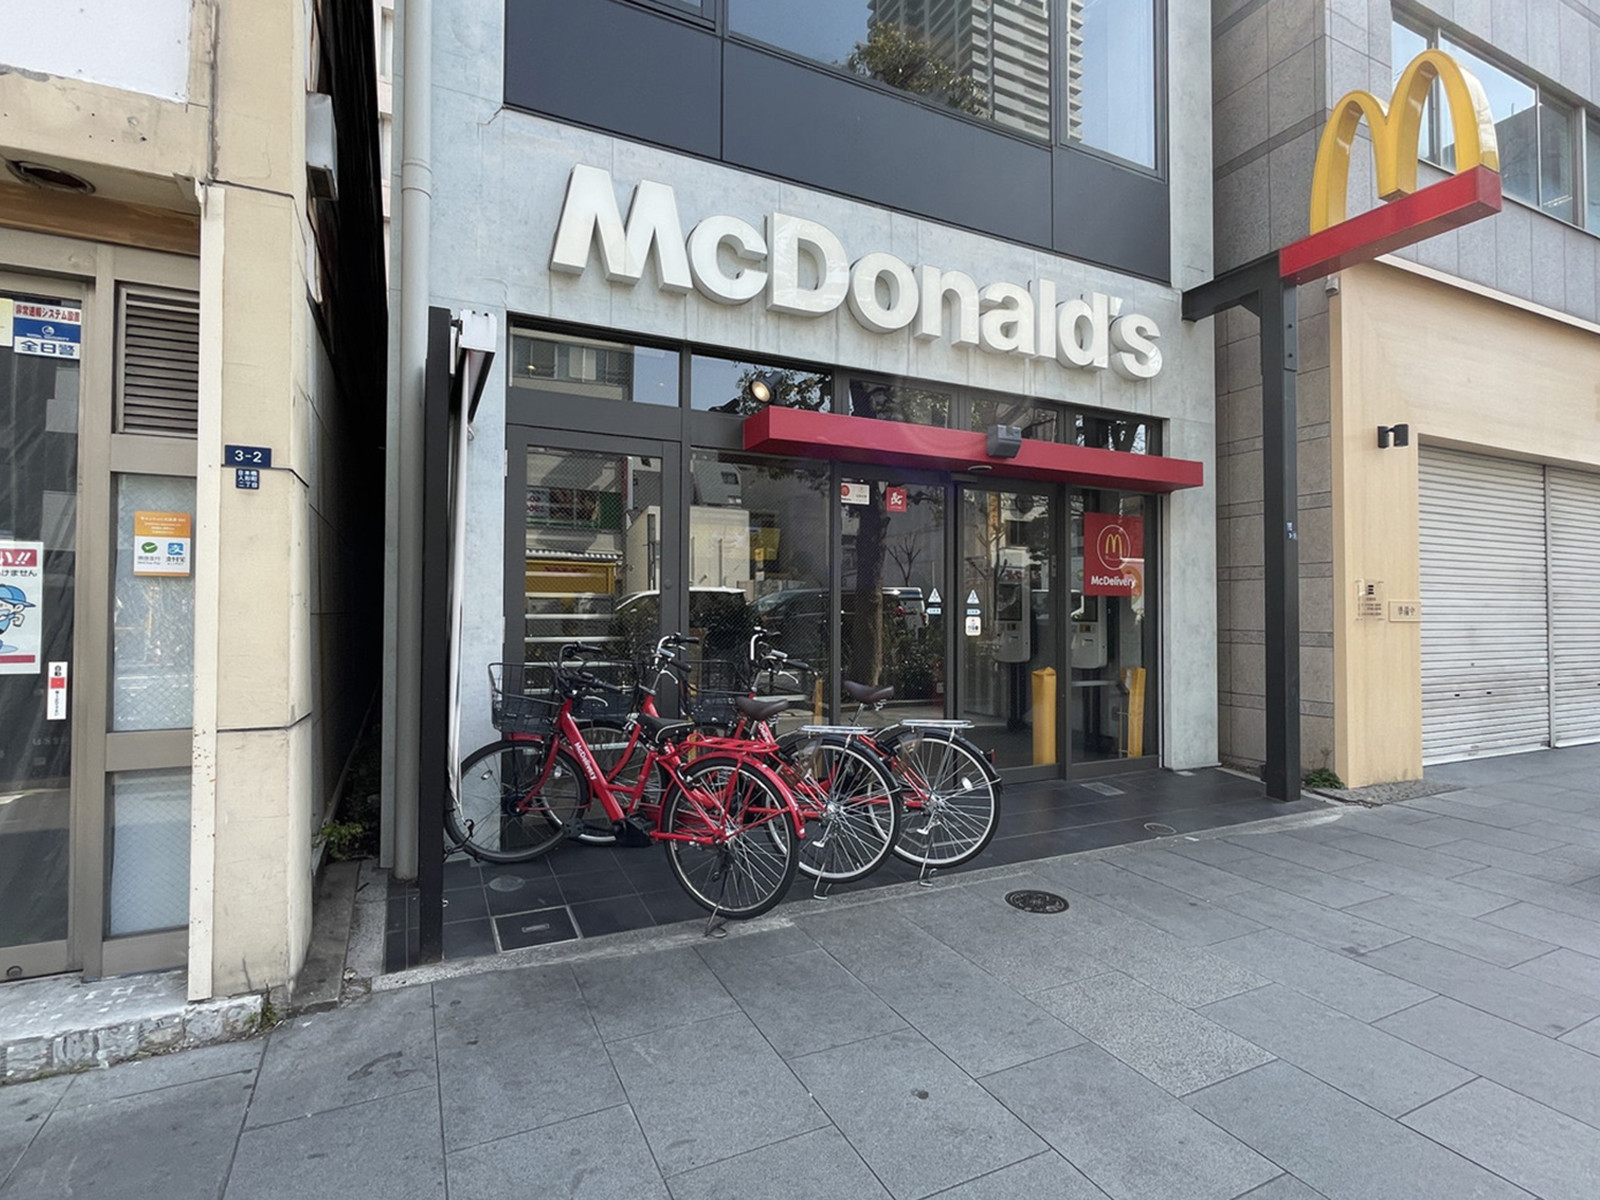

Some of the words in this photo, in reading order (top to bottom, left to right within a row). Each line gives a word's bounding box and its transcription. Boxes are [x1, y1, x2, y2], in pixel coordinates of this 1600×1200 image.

[550, 163, 1163, 381] McDonald's
[234, 449, 262, 463] 3-2
[1090, 575, 1137, 589] McDelivery
[574, 741, 597, 780] McDelivery
